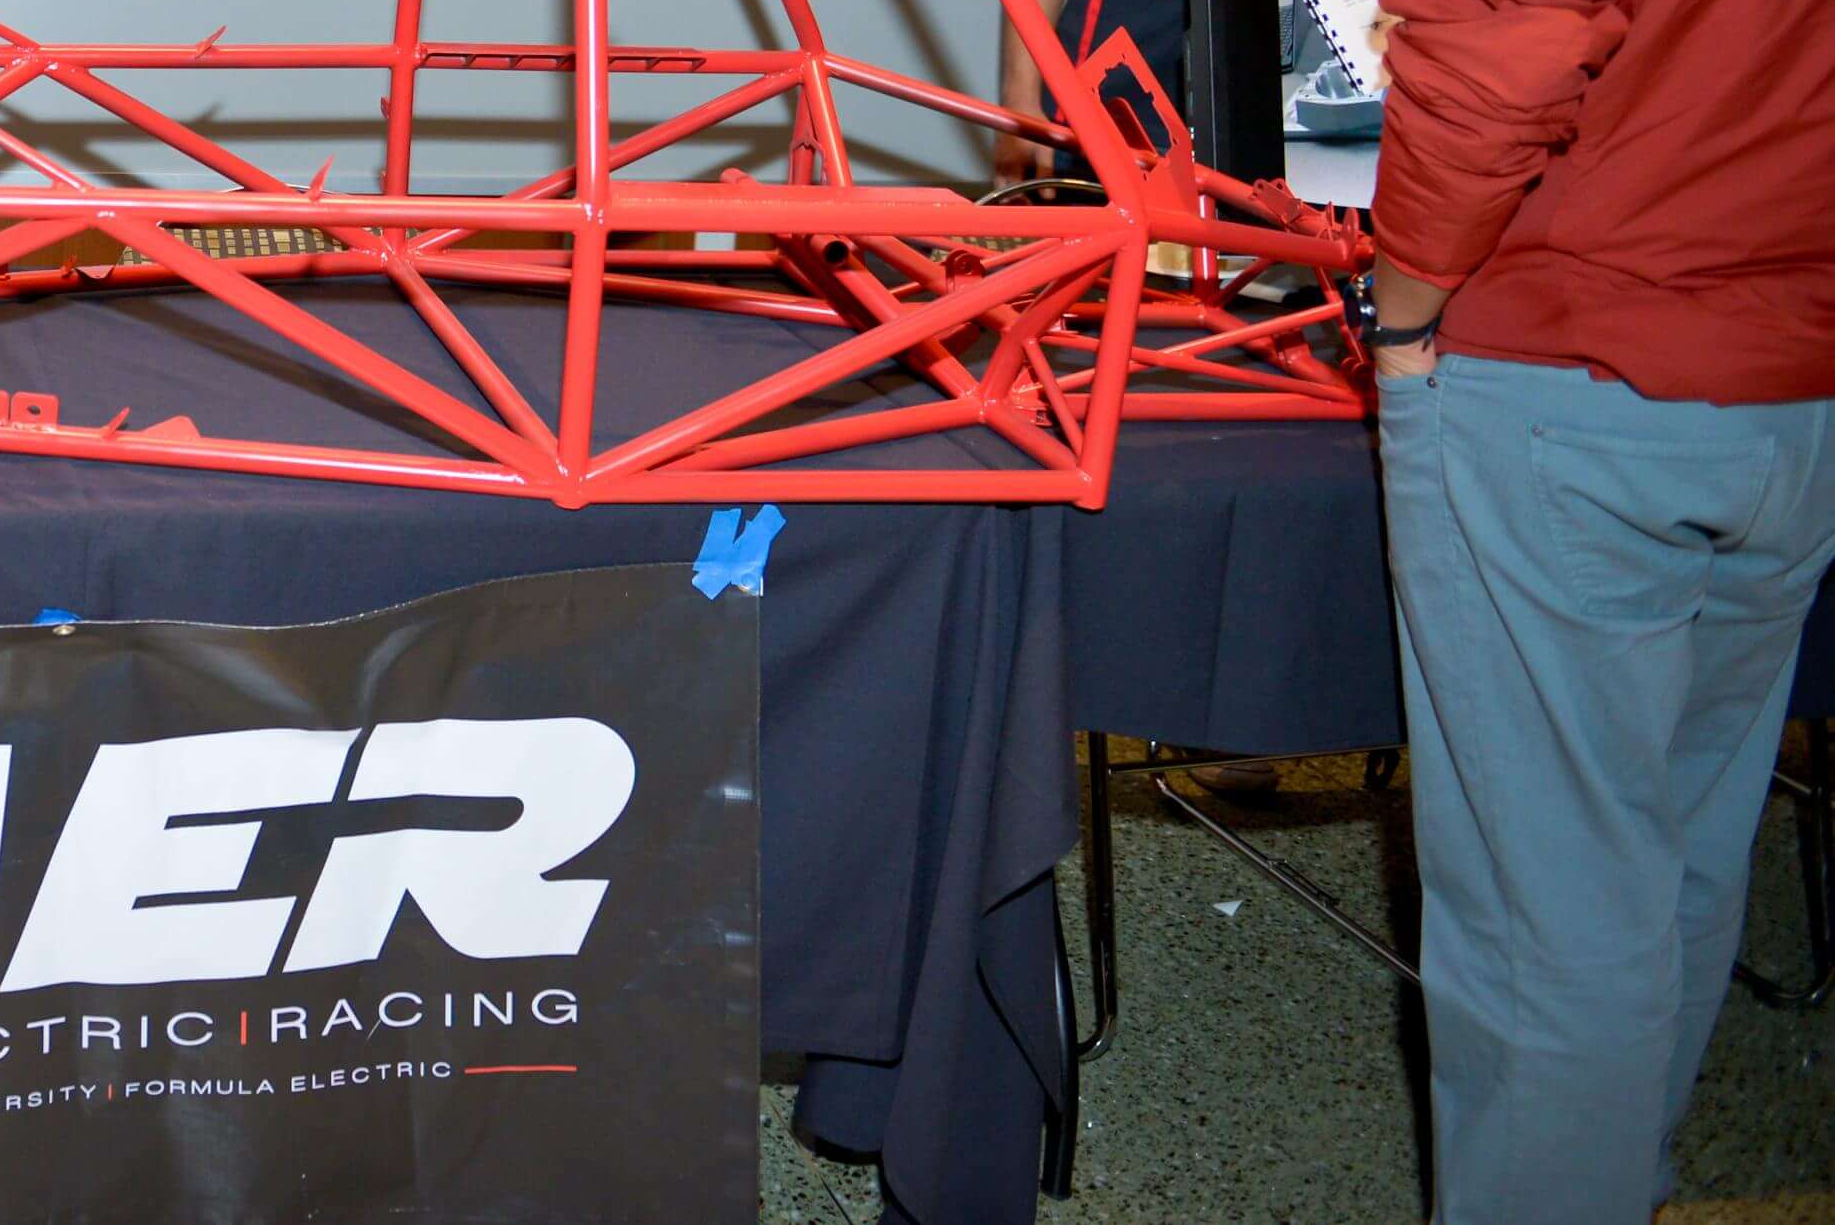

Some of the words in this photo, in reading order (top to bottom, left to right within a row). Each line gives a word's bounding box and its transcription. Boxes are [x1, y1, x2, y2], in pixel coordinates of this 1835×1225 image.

[270, 988, 580, 1044] RACING
[125, 1079, 275, 1099] FORMULA
[291, 1060, 452, 1093] ELECTRIC
